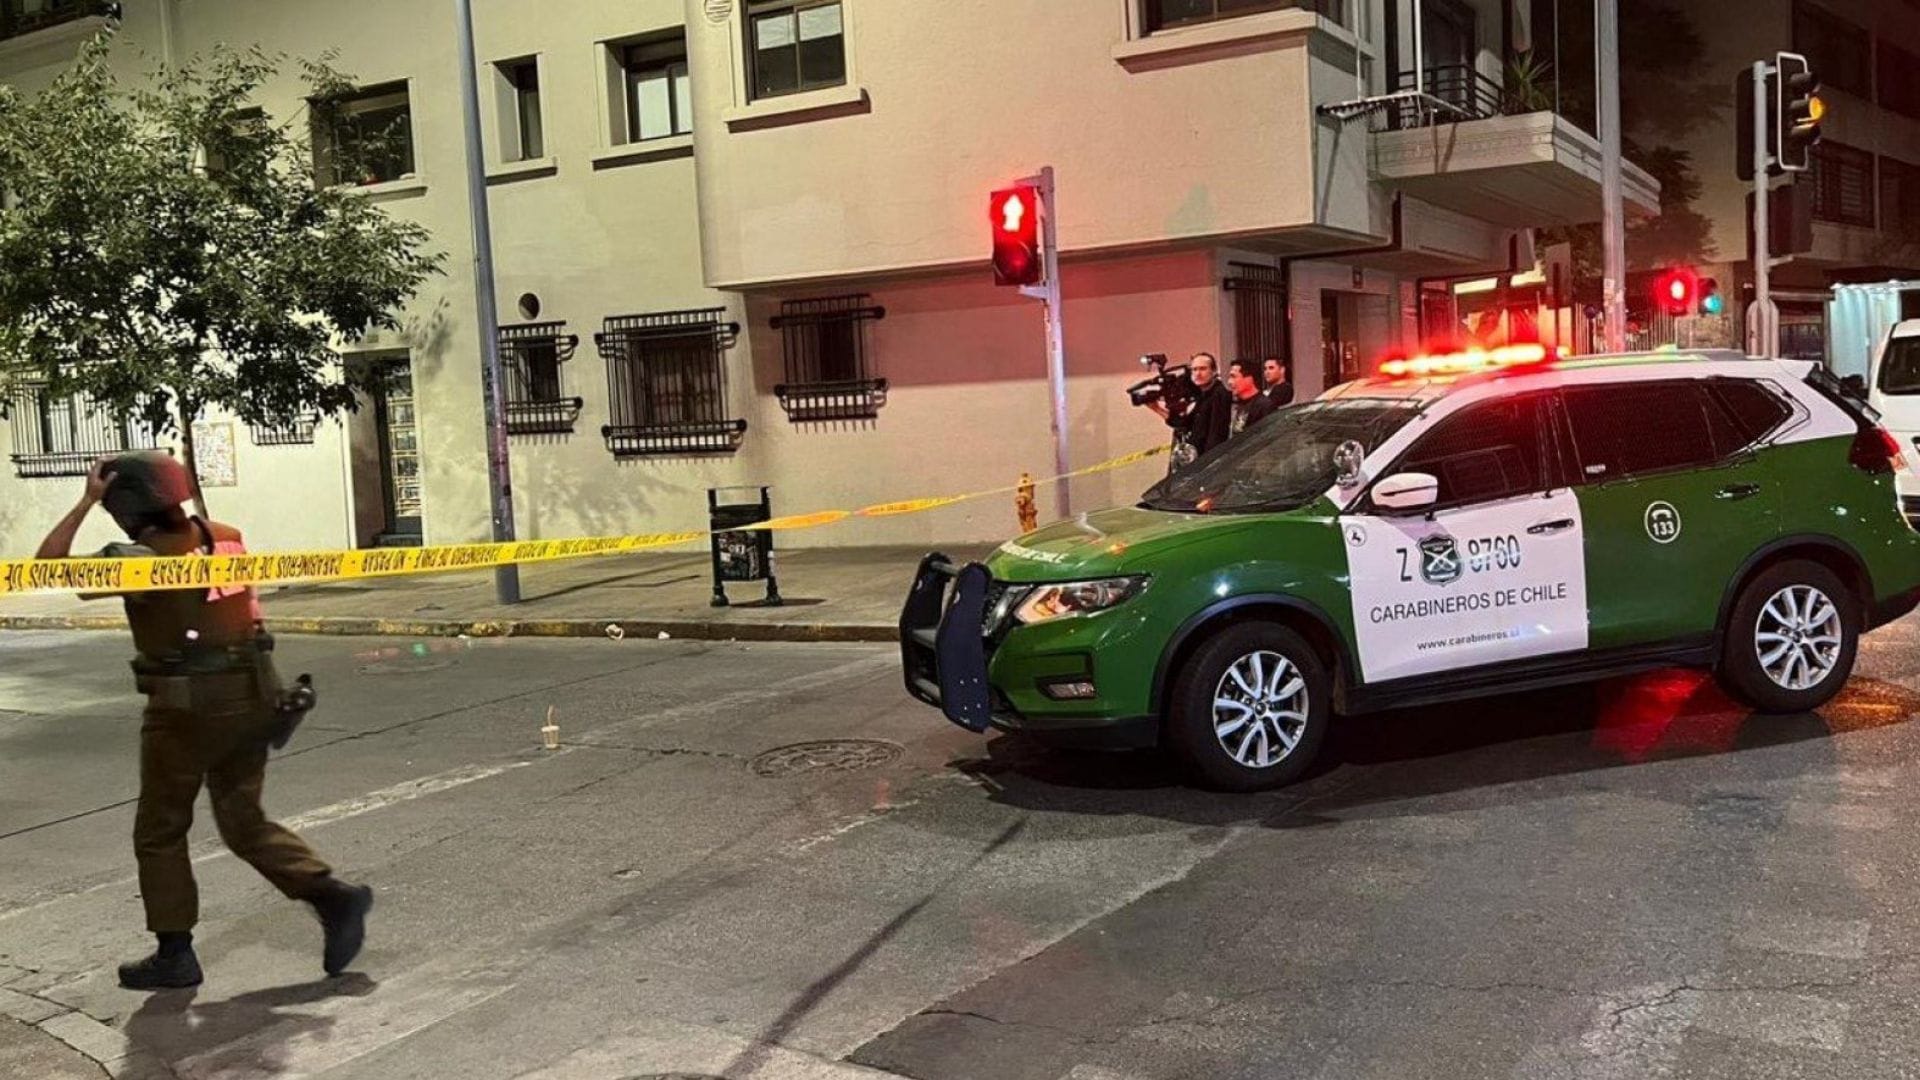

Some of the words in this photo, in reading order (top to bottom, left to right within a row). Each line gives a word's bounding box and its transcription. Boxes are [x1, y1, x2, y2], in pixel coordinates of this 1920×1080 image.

[1653, 521, 1675, 536] 133
[4, 563, 24, 592] DE
[29, 561, 122, 589] CARABINEROS
[151, 559, 194, 585] PASAR
[195, 558, 212, 585] NO
[259, 555, 274, 580] DE
[1396, 548, 1412, 582] Z
[1370, 592, 1491, 623] CARABINEROS
[1495, 589, 1516, 607] DE
[1521, 582, 1567, 604] CHILE
